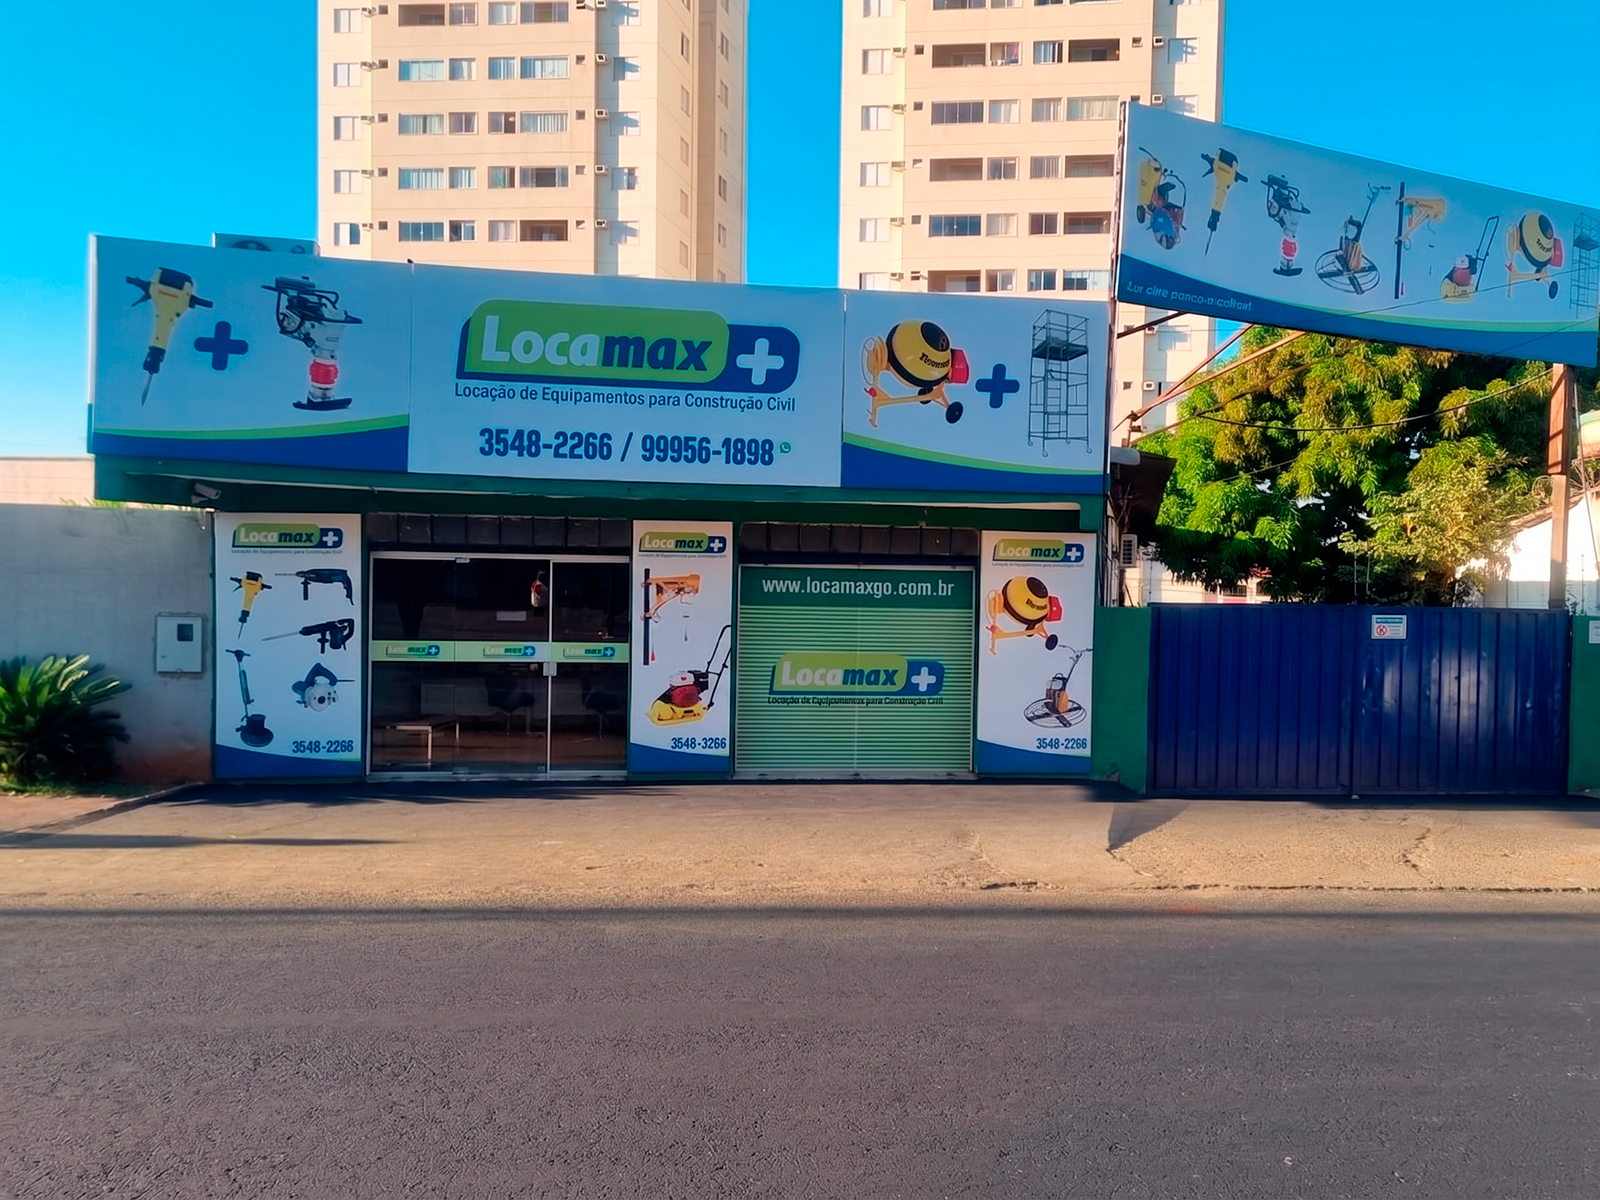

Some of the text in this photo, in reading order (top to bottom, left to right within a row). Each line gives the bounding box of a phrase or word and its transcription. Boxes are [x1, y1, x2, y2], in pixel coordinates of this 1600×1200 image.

[480, 314, 713, 372] Locamax
[455, 382, 796, 412] Locação de Equipamentos para Construção Civil
[478, 427, 613, 460] 3548-2266
[641, 434, 775, 466] 99956-1898
[240, 527, 315, 543] Locamax
[644, 535, 704, 549] Locamax
[998, 543, 1061, 558] Locamax
[762, 576, 954, 598] www.locamaxgo.com.br
[781, 661, 899, 686] Locamax
[292, 740, 354, 753] 3548-2266
[1036, 738, 1087, 749] 3548-2266
